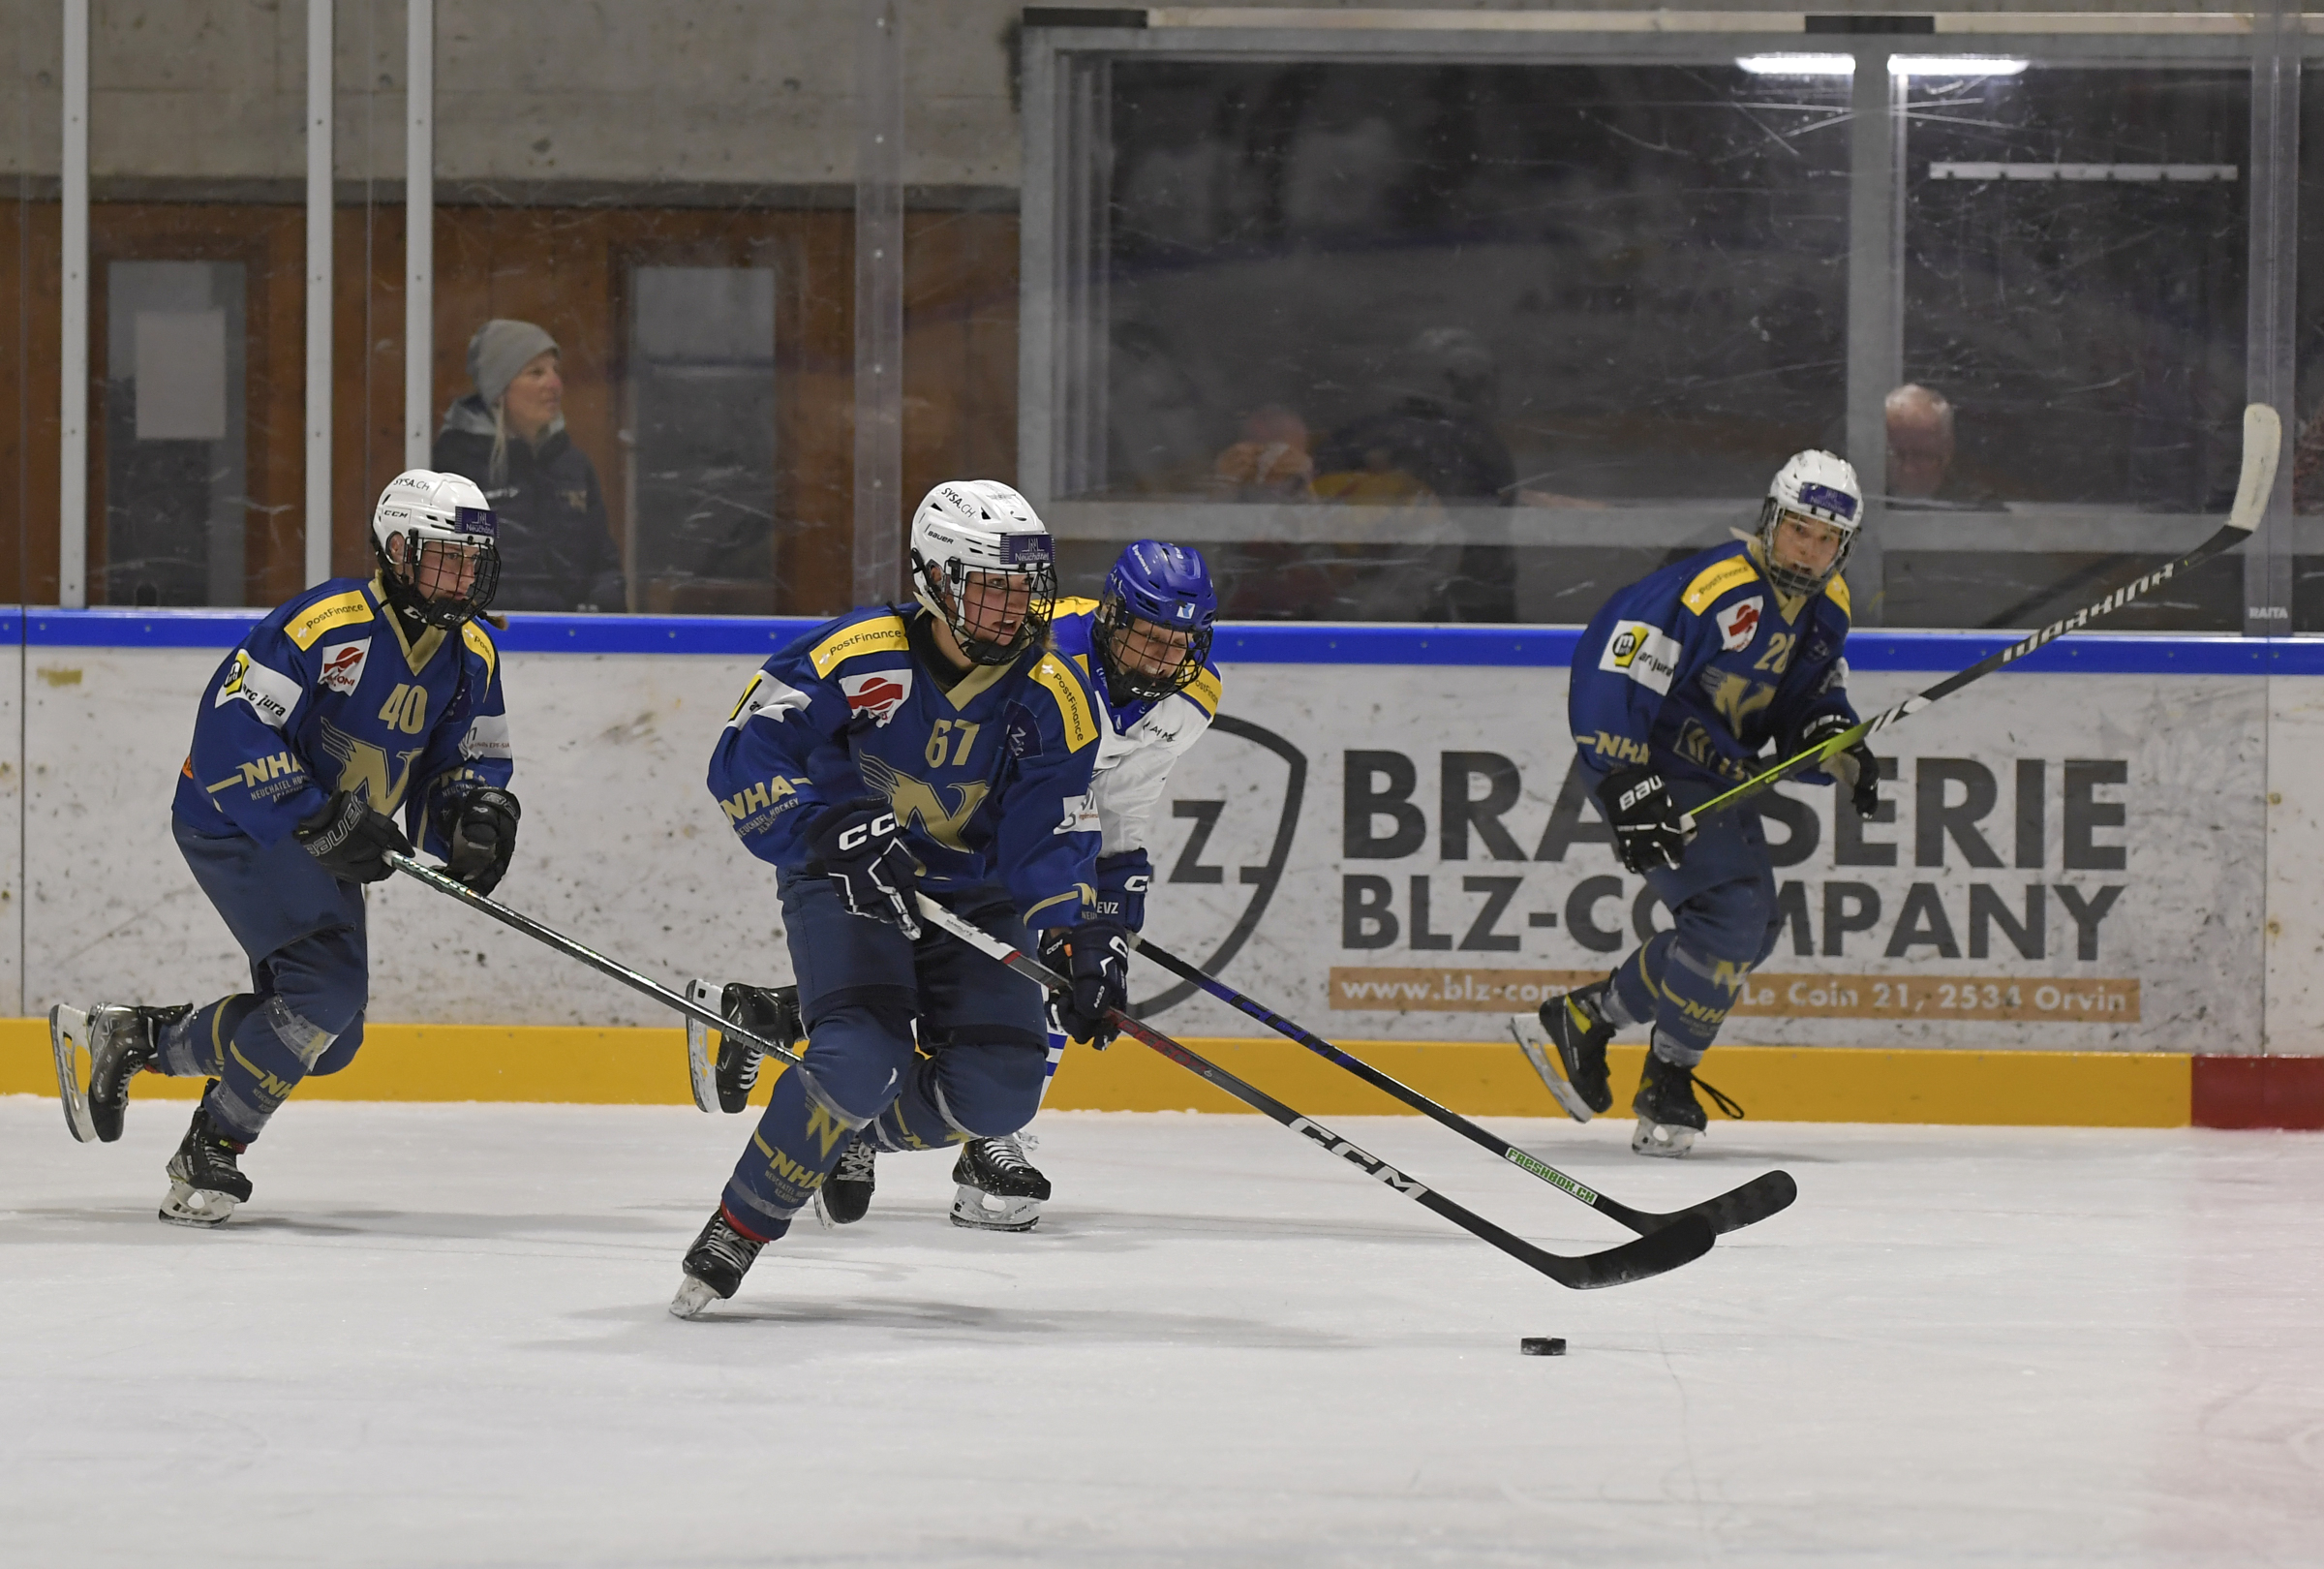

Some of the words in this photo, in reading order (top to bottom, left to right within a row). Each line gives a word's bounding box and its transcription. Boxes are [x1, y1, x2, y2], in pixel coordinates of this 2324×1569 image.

[383, 509, 409, 518] CCM
[941, 487, 976, 517] SYSA.CH
[927, 531, 954, 544] BAUER
[306, 603, 364, 630] PostFinance
[829, 629, 902, 656] PostFinance
[242, 683, 258, 701] arc
[258, 695, 286, 717] jura
[379, 683, 428, 734] 40
[1054, 673, 1084, 741] PostFinance
[925, 720, 979, 768] 67
[250, 781, 290, 801] NEUCHATEL
[719, 775, 796, 826] NHA
[770, 797, 800, 818] HOCKEY
[1343, 750, 2128, 870] BRASERIE
[839, 812, 900, 850] CC
[1096, 902, 1118, 914] EVZ
[1743, 981, 1775, 1005] Le
[1788, 981, 1858, 1007] Coin
[1873, 982, 1925, 1012] 21,
[1939, 984, 2023, 1010] 2534
[2034, 985, 2126, 1012] Orvin
[258, 1069, 293, 1098] NH
[770, 1147, 825, 1189] NHA
[1289, 1117, 1428, 1200] CCM
[1507, 1148, 1596, 1204] FRESHBOX.CH
